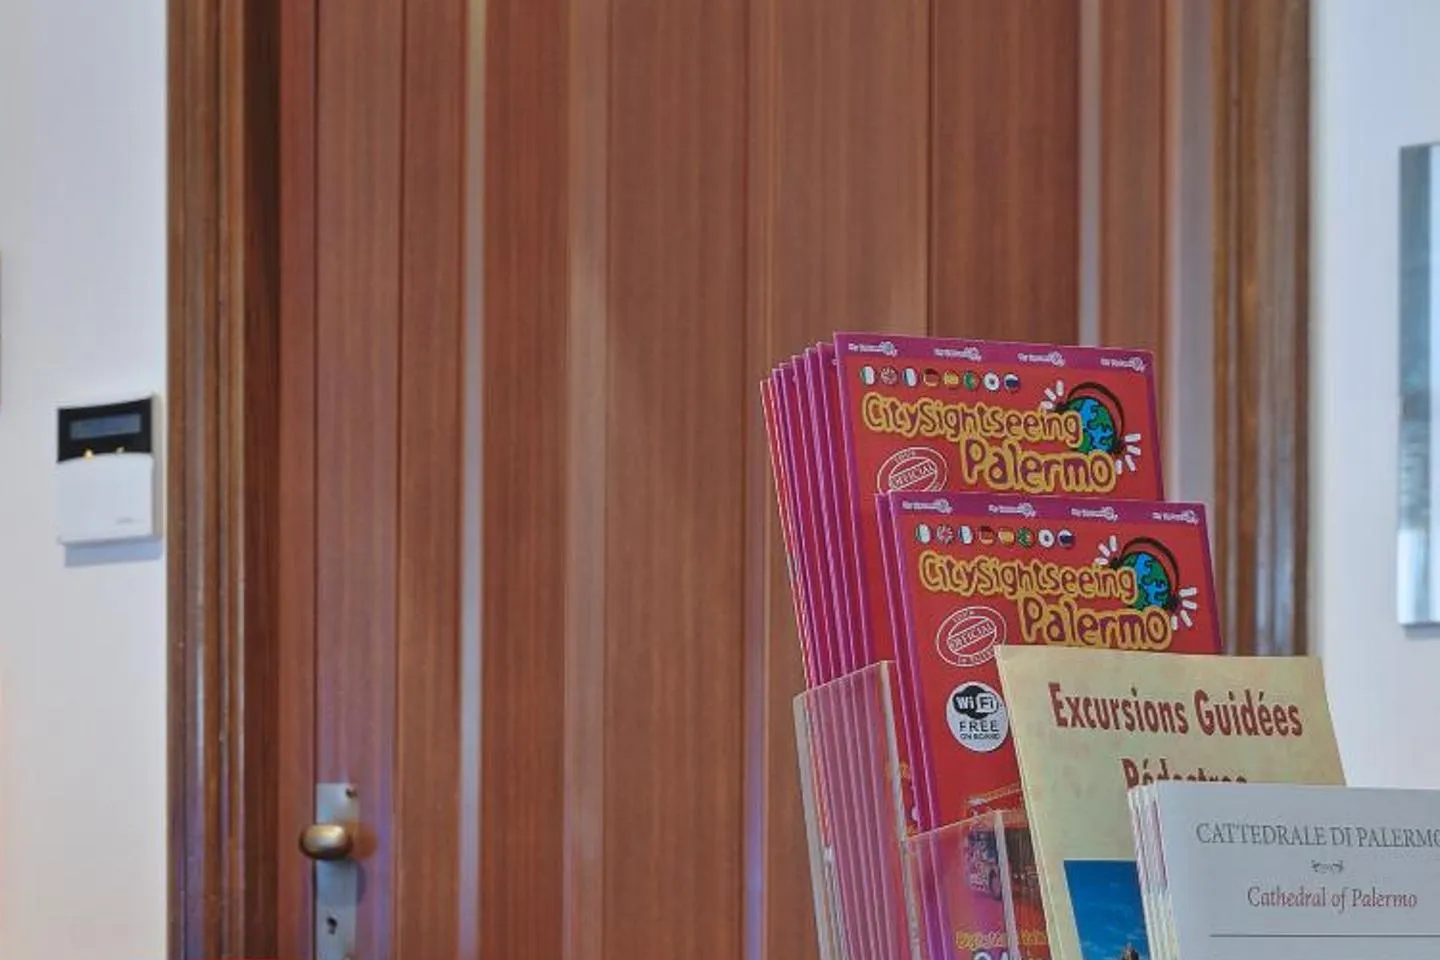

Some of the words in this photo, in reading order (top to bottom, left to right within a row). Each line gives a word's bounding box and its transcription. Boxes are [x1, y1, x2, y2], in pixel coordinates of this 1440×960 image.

[961, 436, 1117, 494] Palermo
[1016, 597, 1174, 652] Palermo
[959, 719, 1000, 733] FREE
[1048, 682, 1189, 734] Excursions
[1194, 689, 1303, 736] Guidées
[1196, 823, 1327, 847] CATTEDRALE
[1331, 826, 1351, 847] DI
[1247, 886, 1326, 908] Cathedral
[1331, 887, 1348, 914] of
[1352, 888, 1417, 908] Palermo
